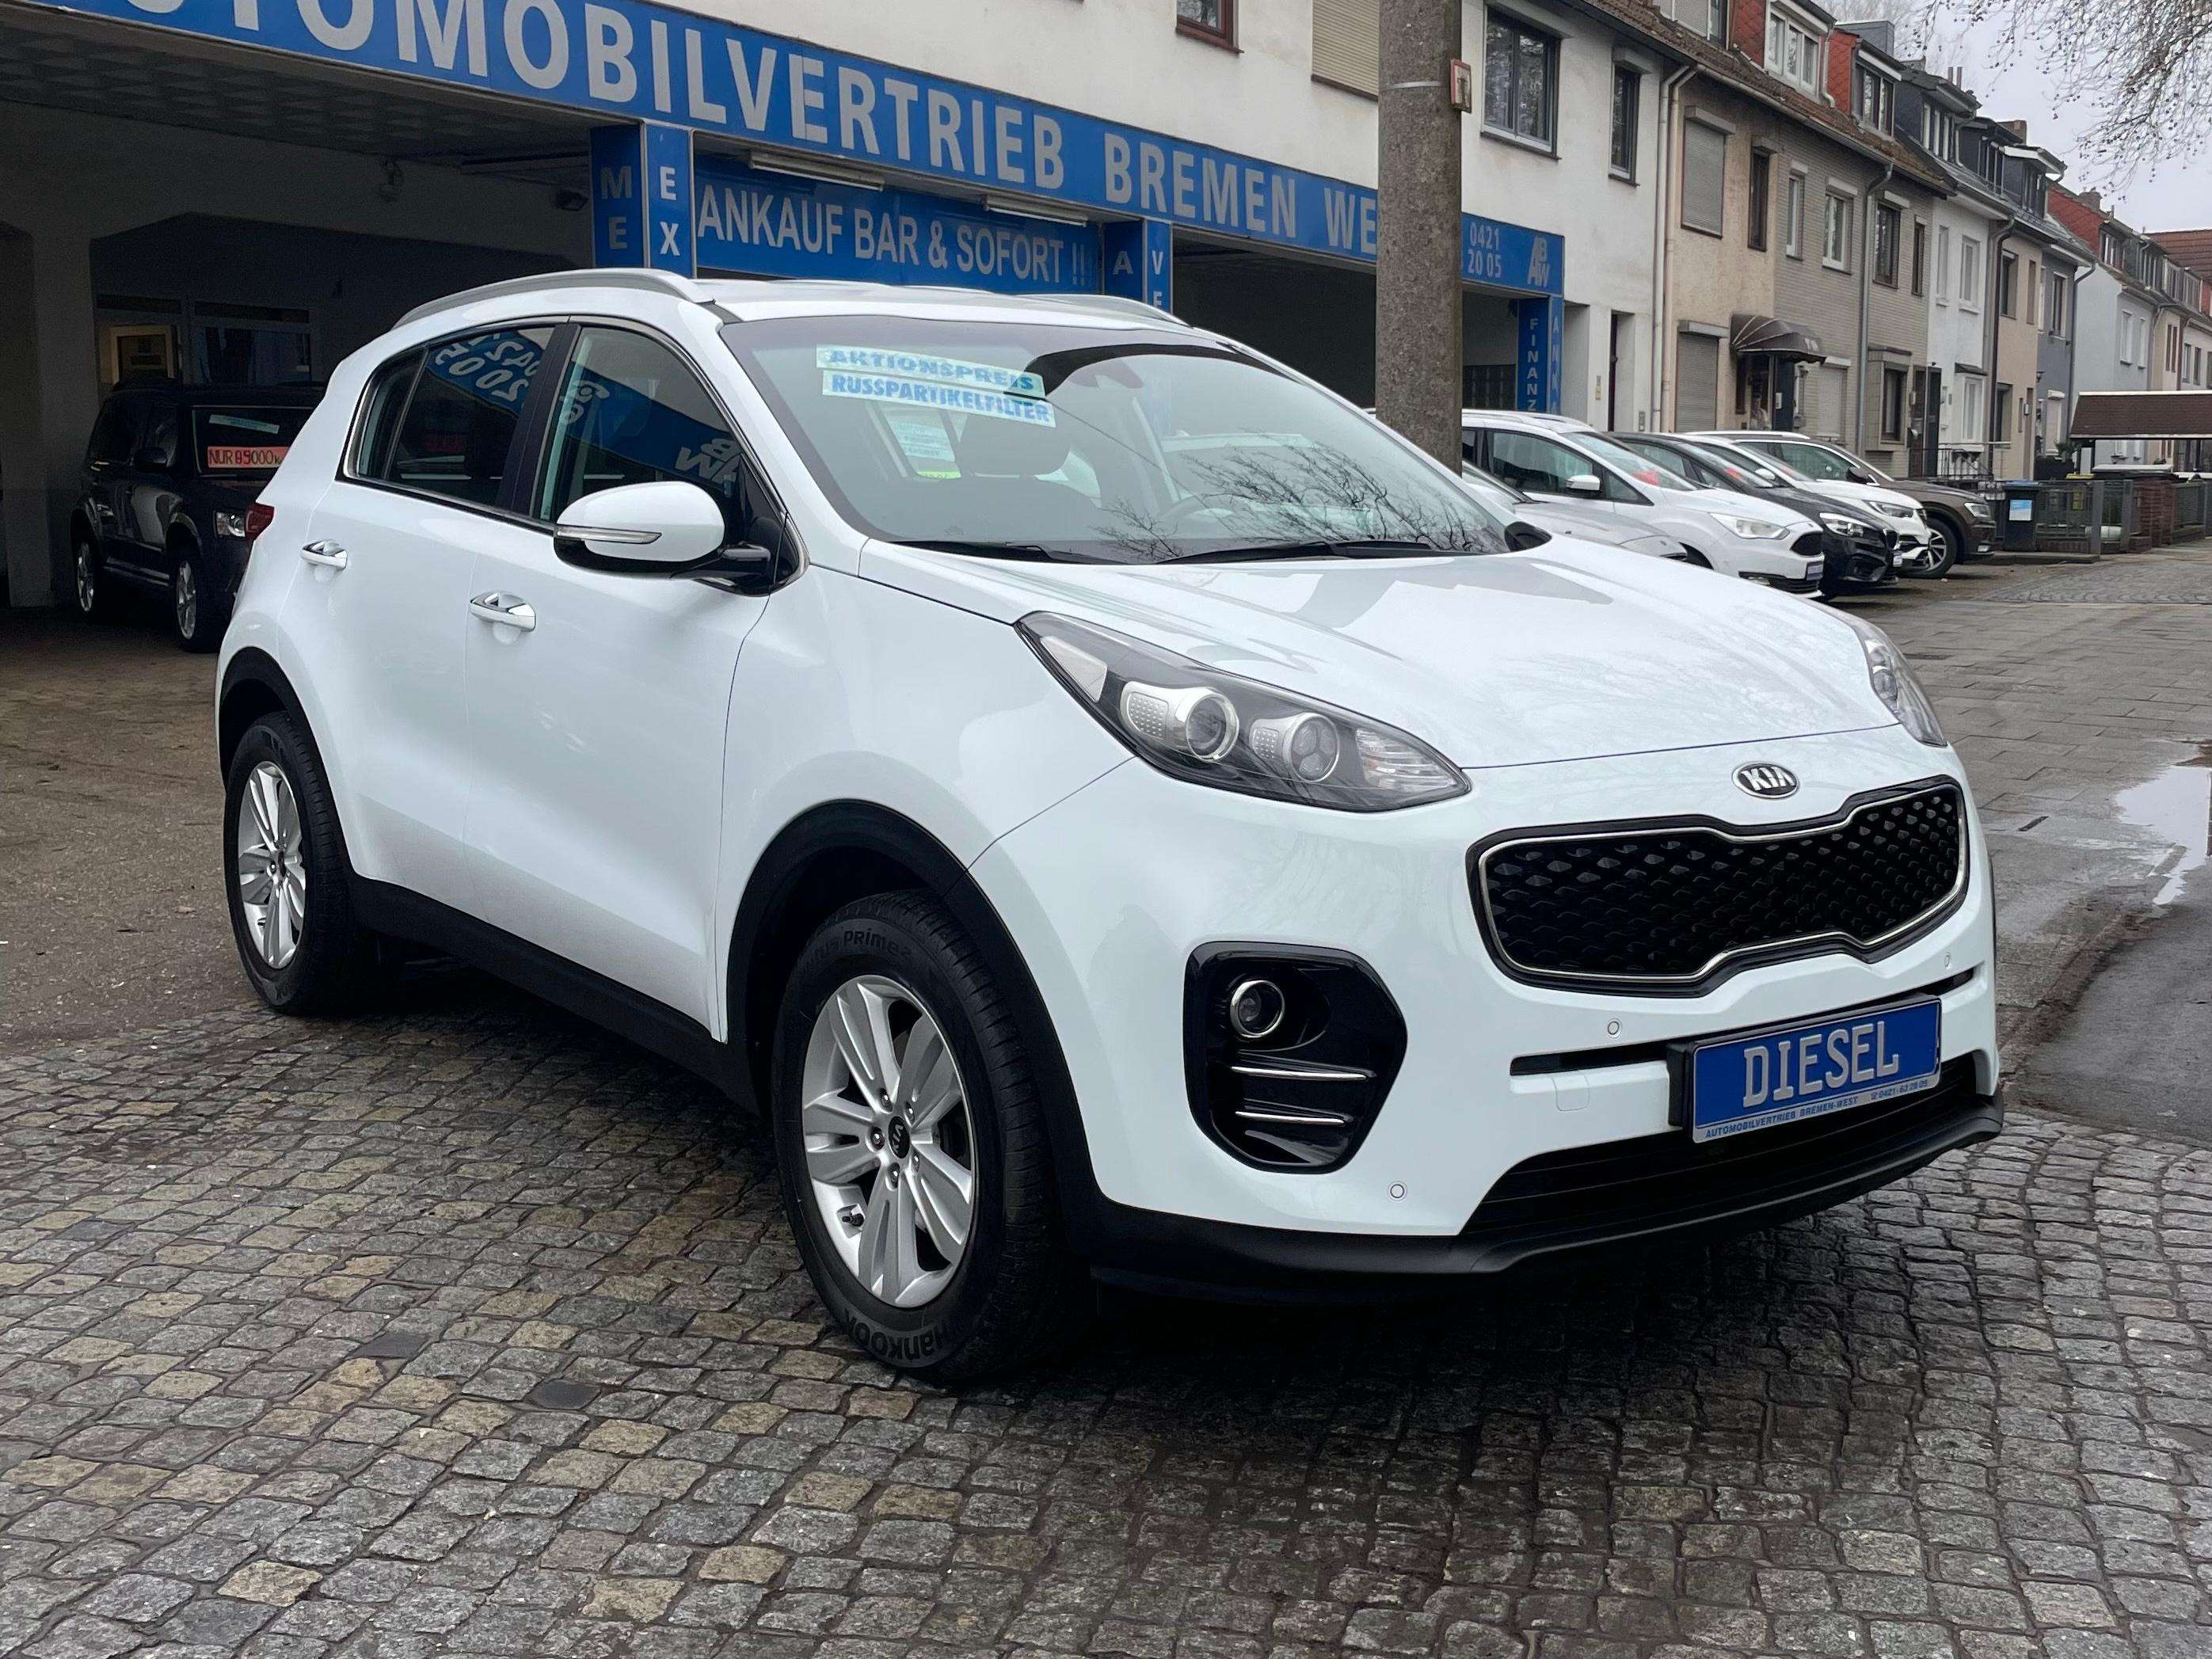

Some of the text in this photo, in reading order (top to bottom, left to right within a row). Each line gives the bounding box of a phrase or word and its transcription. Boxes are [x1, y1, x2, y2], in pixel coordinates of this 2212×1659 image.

[127, 0, 1064, 190] MOBILVERTRIEB
[1104, 133, 1296, 238] BREMEN
[698, 184, 843, 255] ANKAUF
[855, 208, 919, 265] BAR
[929, 223, 948, 270] &
[957, 225, 1063, 283] SOFORT
[1470, 222, 1500, 251] 0421
[1468, 249, 1502, 277] 20 05
[832, 350, 1034, 390] AKTIONSPREIS
[832, 375, 1049, 421] RUSSPARTIKELFILTER
[209, 450, 233, 465] NUR
[1741, 766, 1795, 791] KIA
[1743, 1021, 1899, 1108] DIESEL
[1705, 1111, 1796, 1139] AUTOMOBILVERTRIEB
